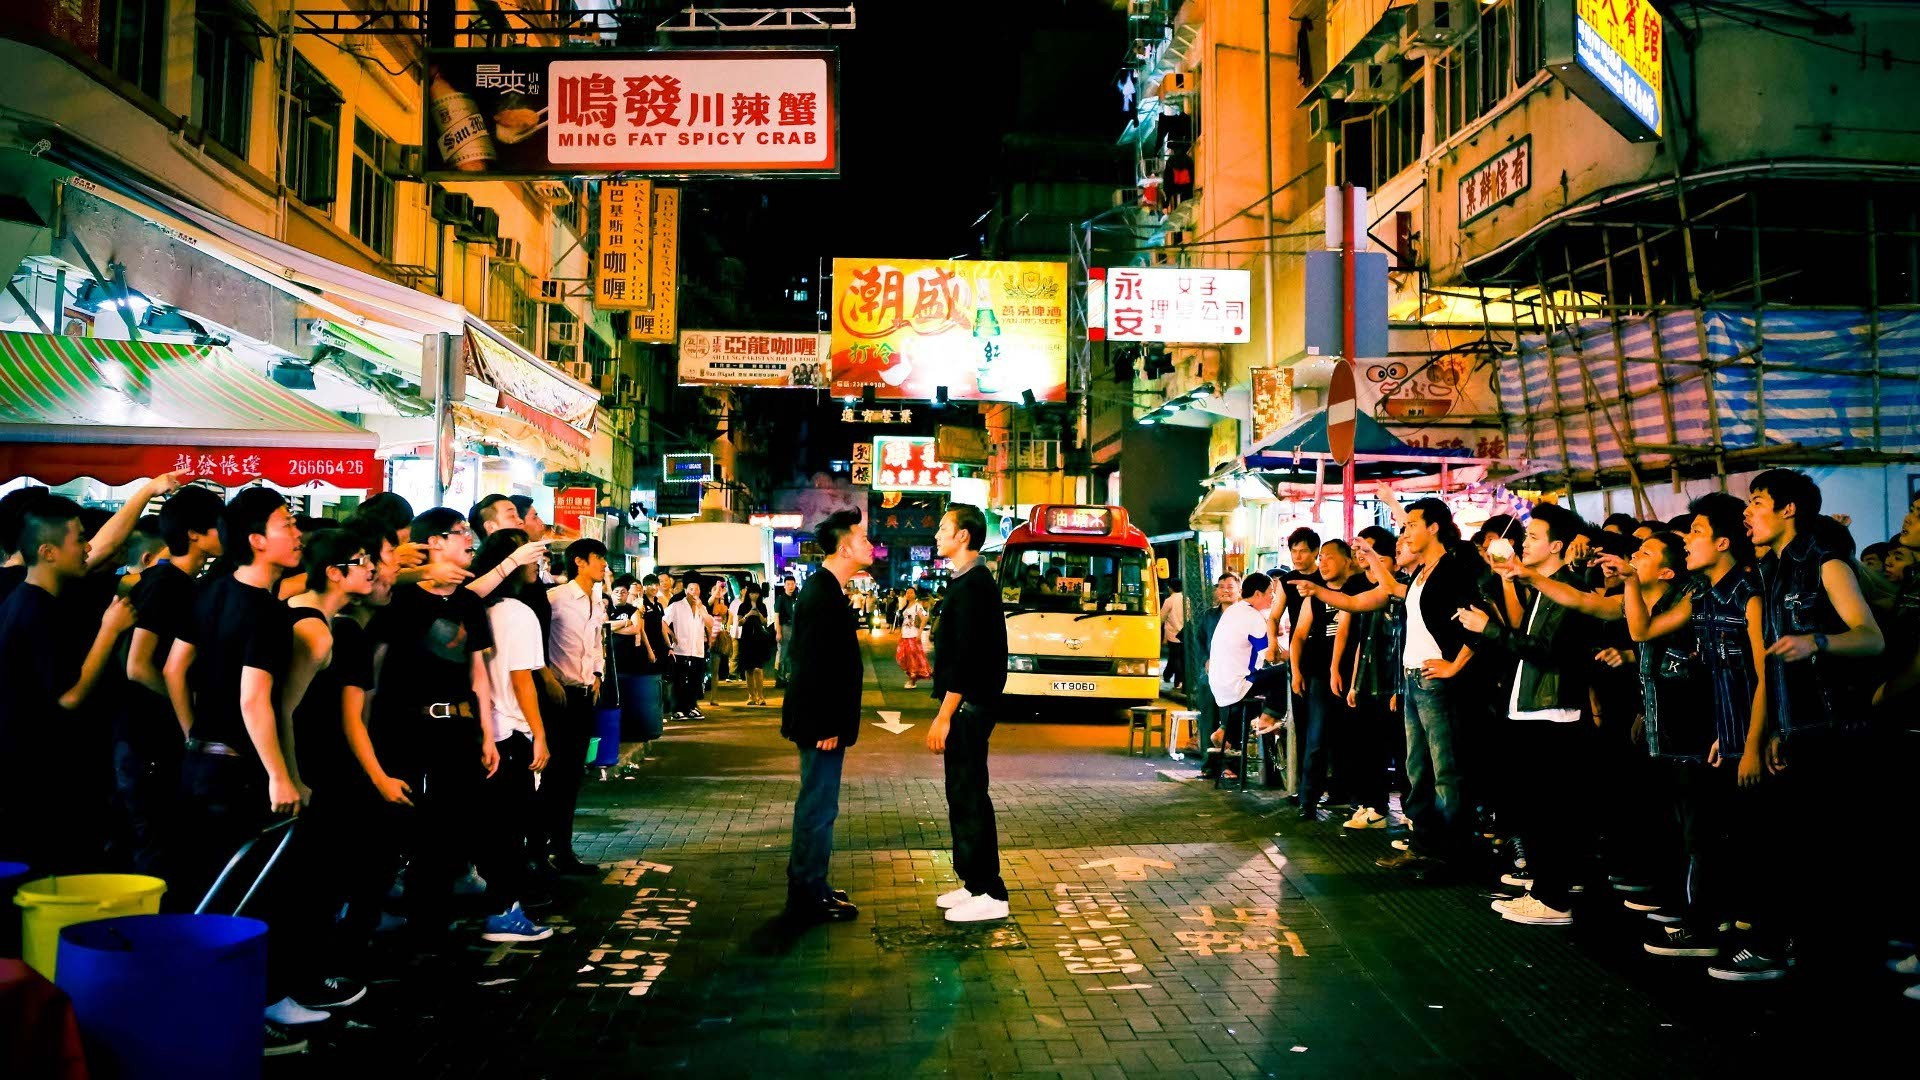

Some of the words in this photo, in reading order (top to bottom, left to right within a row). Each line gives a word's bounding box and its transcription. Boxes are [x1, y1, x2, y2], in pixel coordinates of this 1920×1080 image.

[443, 126, 471, 152] San
[558, 132, 617, 147] MING
[628, 132, 667, 146] FAT
[678, 132, 746, 146] SPICY
[756, 132, 817, 145] CRAB
[603, 180, 628, 300] 巴基斯坦咖喱
[1178, 275, 1218, 297] 女子
[1114, 272, 1143, 336] 永安
[1150, 299, 1244, 321] 理公司
[288, 459, 364, 475] 26666426
[1668, 660, 1680, 673] K
